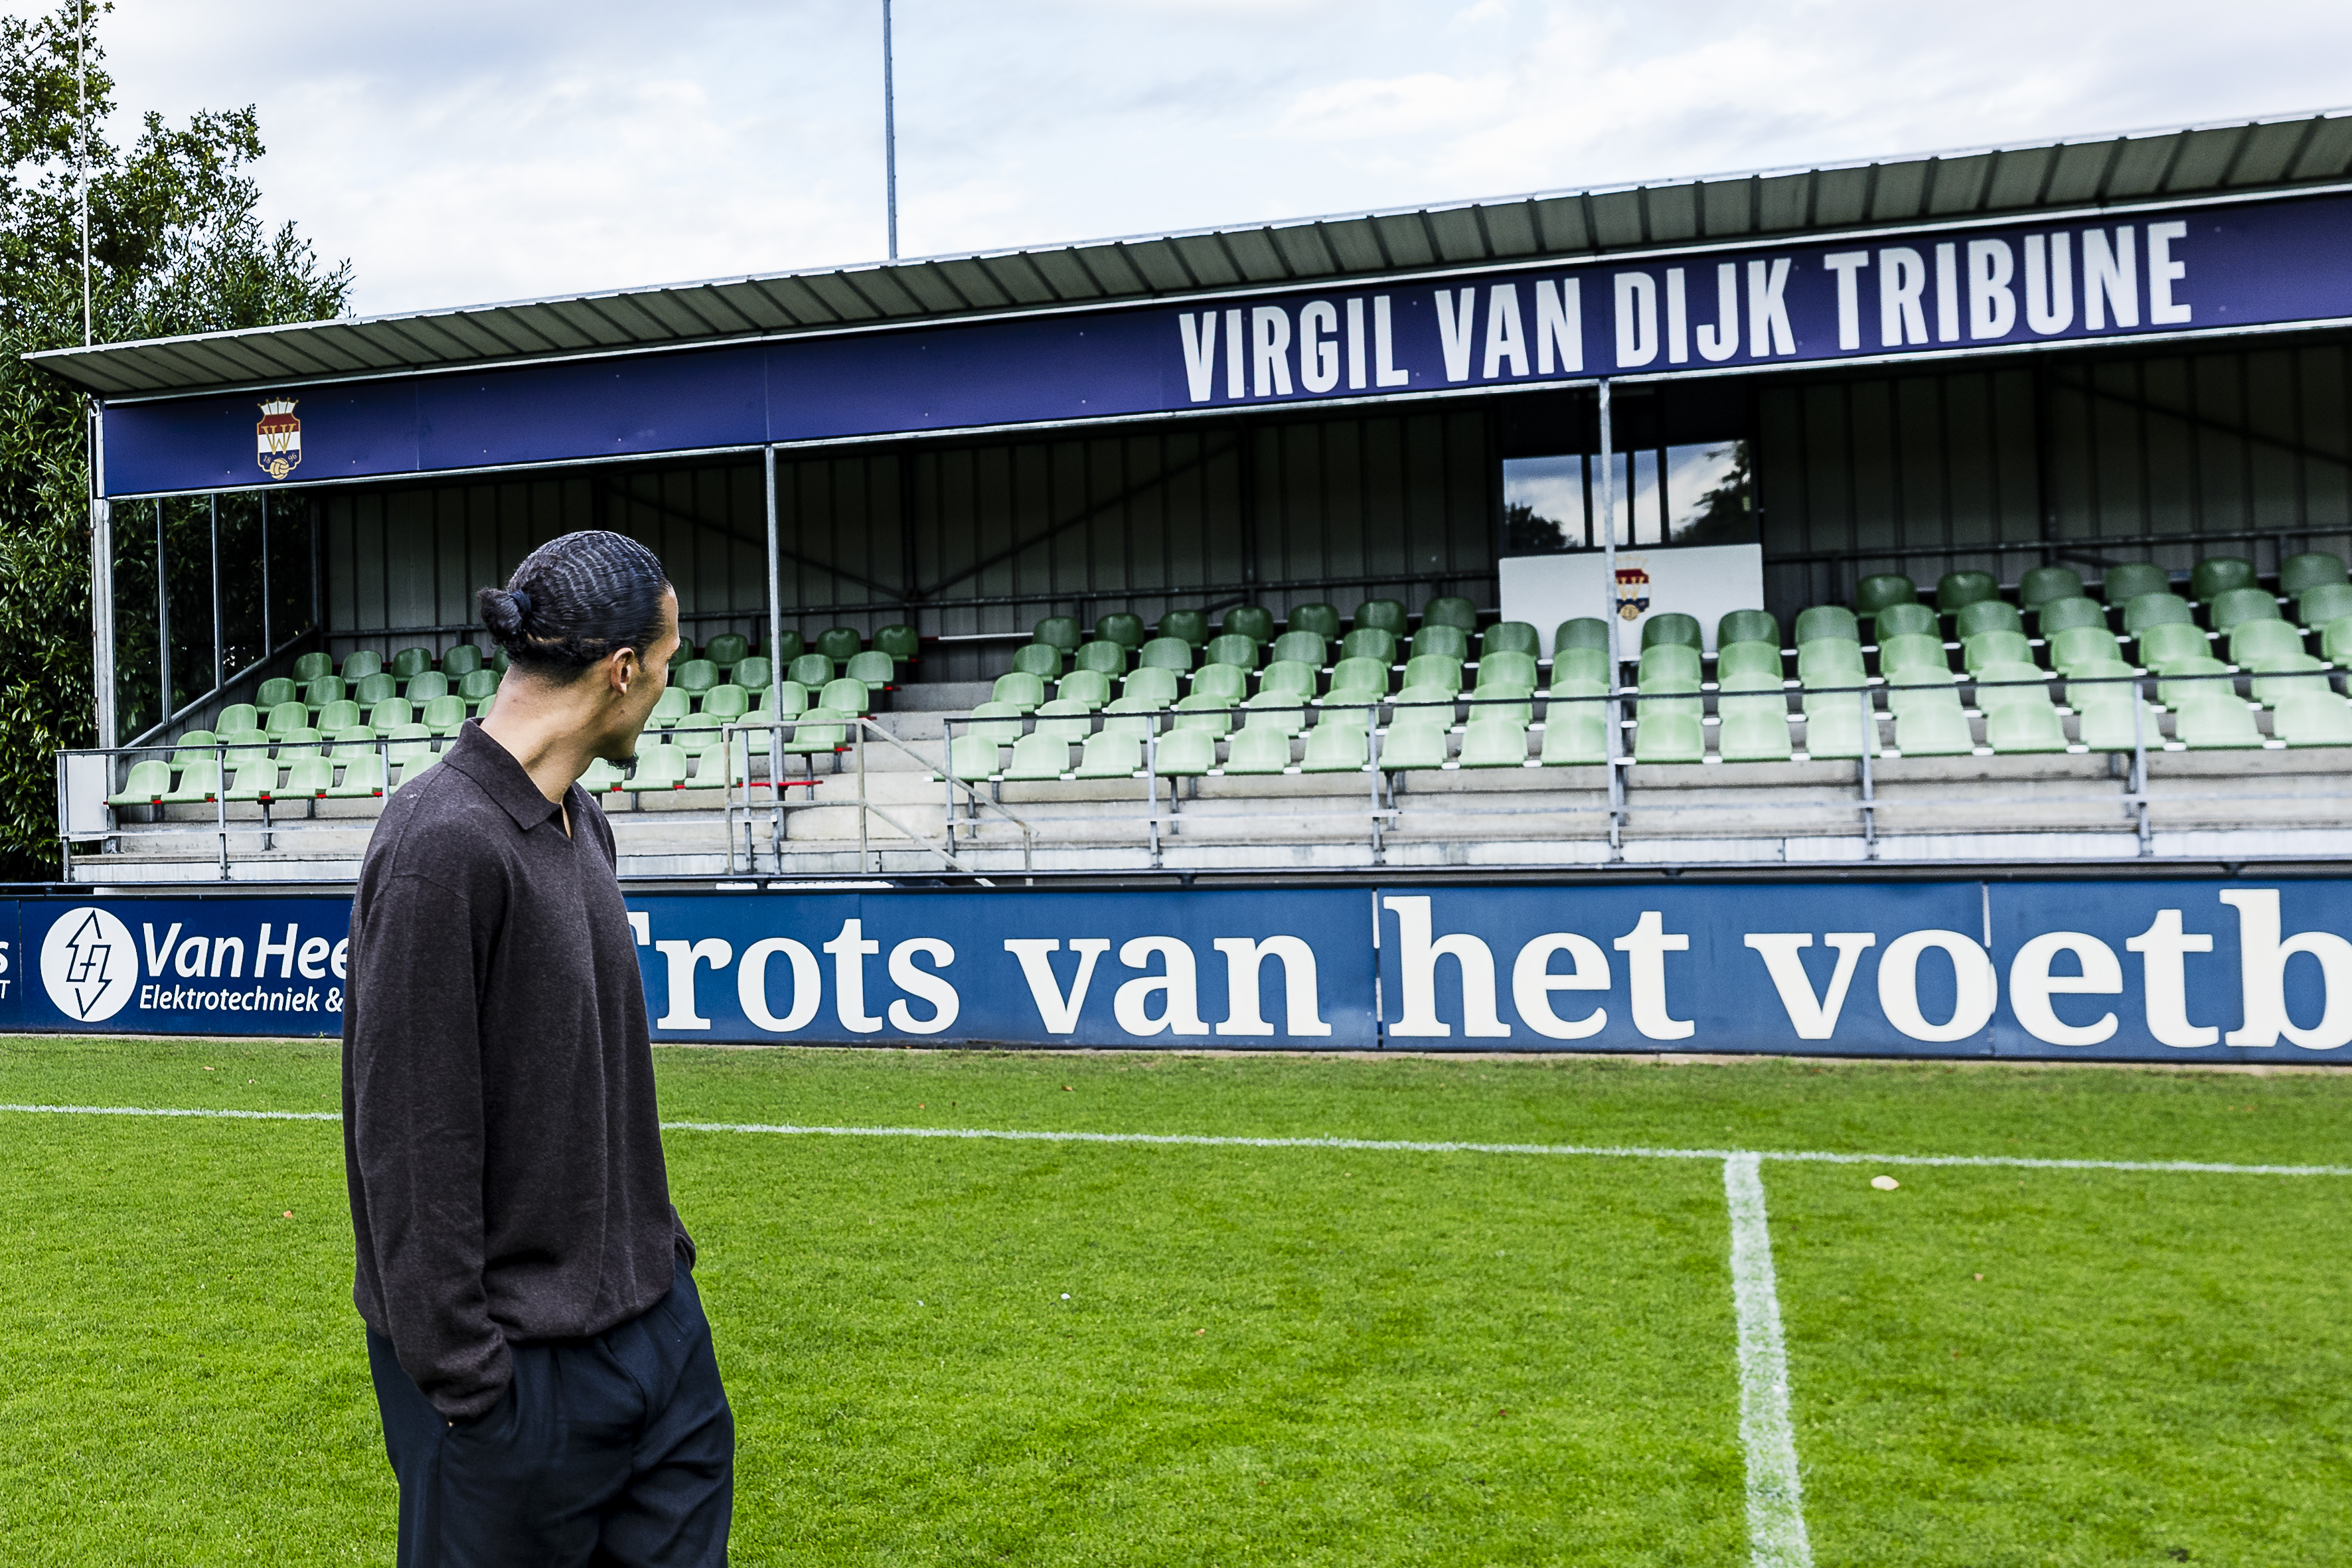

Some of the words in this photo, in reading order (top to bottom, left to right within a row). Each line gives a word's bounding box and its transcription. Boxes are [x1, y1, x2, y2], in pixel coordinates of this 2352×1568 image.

[1179, 295, 1409, 402] VIRGIL
[1435, 277, 1583, 382] VAN
[1614, 258, 1796, 368] DIJK
[1824, 221, 2192, 351] TRIBUNE
[139, 984, 320, 1012] Elektrotechniek
[325, 986, 344, 1012] &
[143, 922, 244, 979] Van
[1004, 936, 1332, 1036] van
[1383, 896, 1695, 1040] het
[1743, 888, 2352, 1050] voetb
